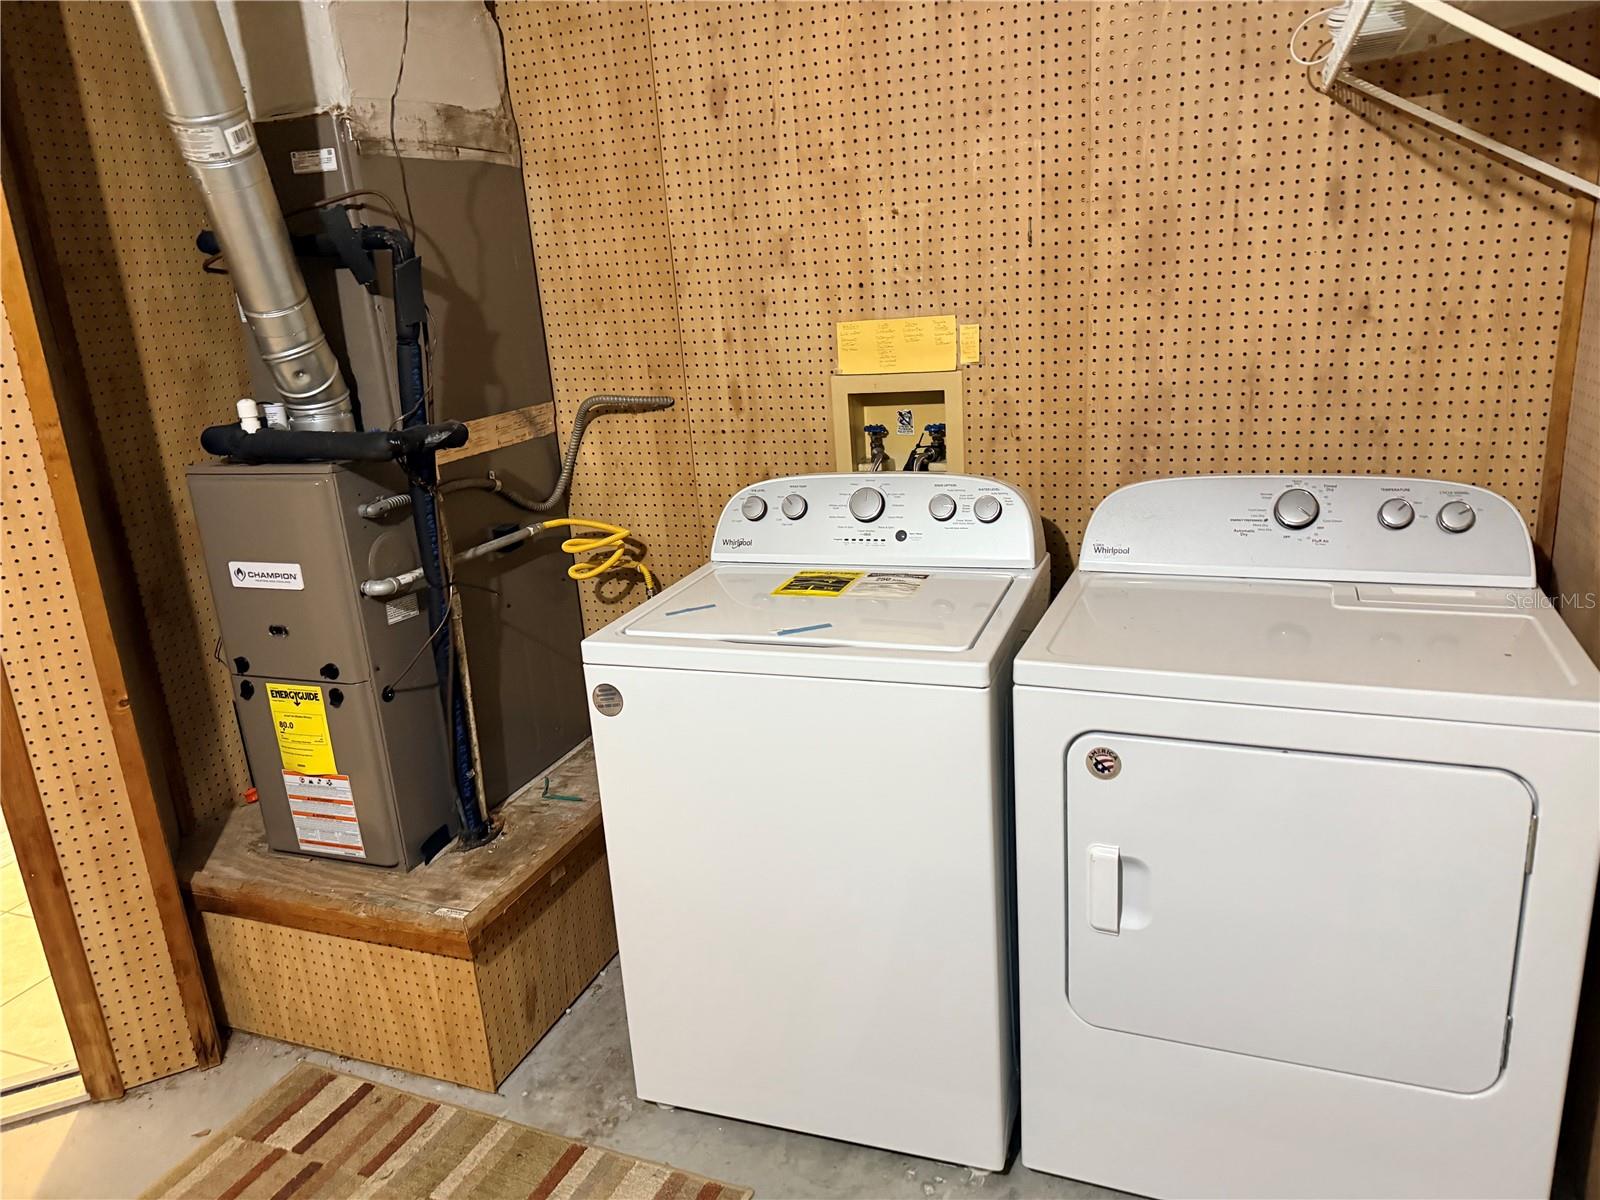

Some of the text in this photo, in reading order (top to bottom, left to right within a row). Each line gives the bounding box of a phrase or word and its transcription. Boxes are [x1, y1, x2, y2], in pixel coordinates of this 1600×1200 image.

[722, 538, 753, 549] Whirlpool
[1093, 545, 1130, 555] Whirlpool
[247, 571, 297, 580] CHAMPION
[270, 689, 320, 702] ENERGYGUIDE
